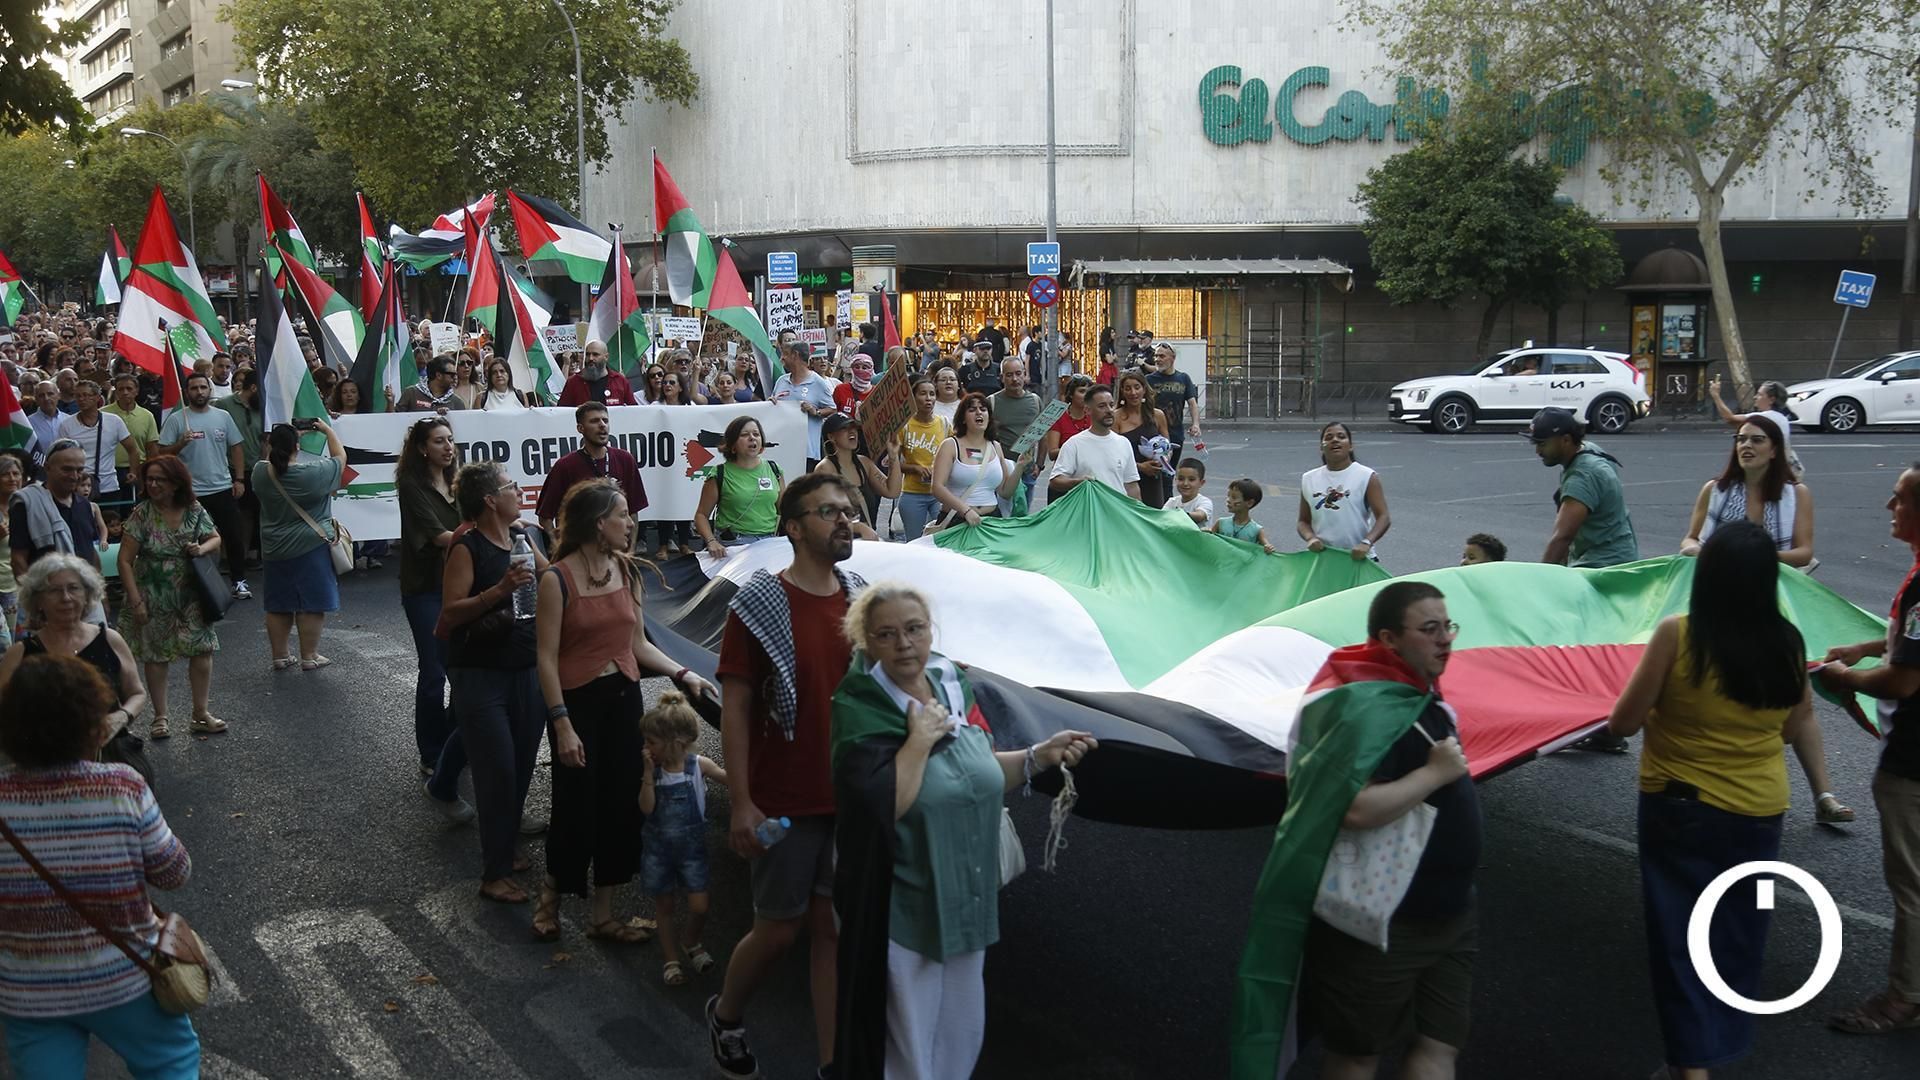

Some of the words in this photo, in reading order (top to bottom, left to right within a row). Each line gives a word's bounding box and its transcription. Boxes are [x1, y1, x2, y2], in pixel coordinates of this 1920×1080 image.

[1199, 64, 1273, 146] El
[1030, 254, 1058, 265] TAXI
[1841, 281, 1872, 297] TAXI
[785, 291, 799, 302] AL
[771, 317, 782, 327] DE
[1550, 380, 1585, 389] KIA
[454, 441, 511, 464] TOP
